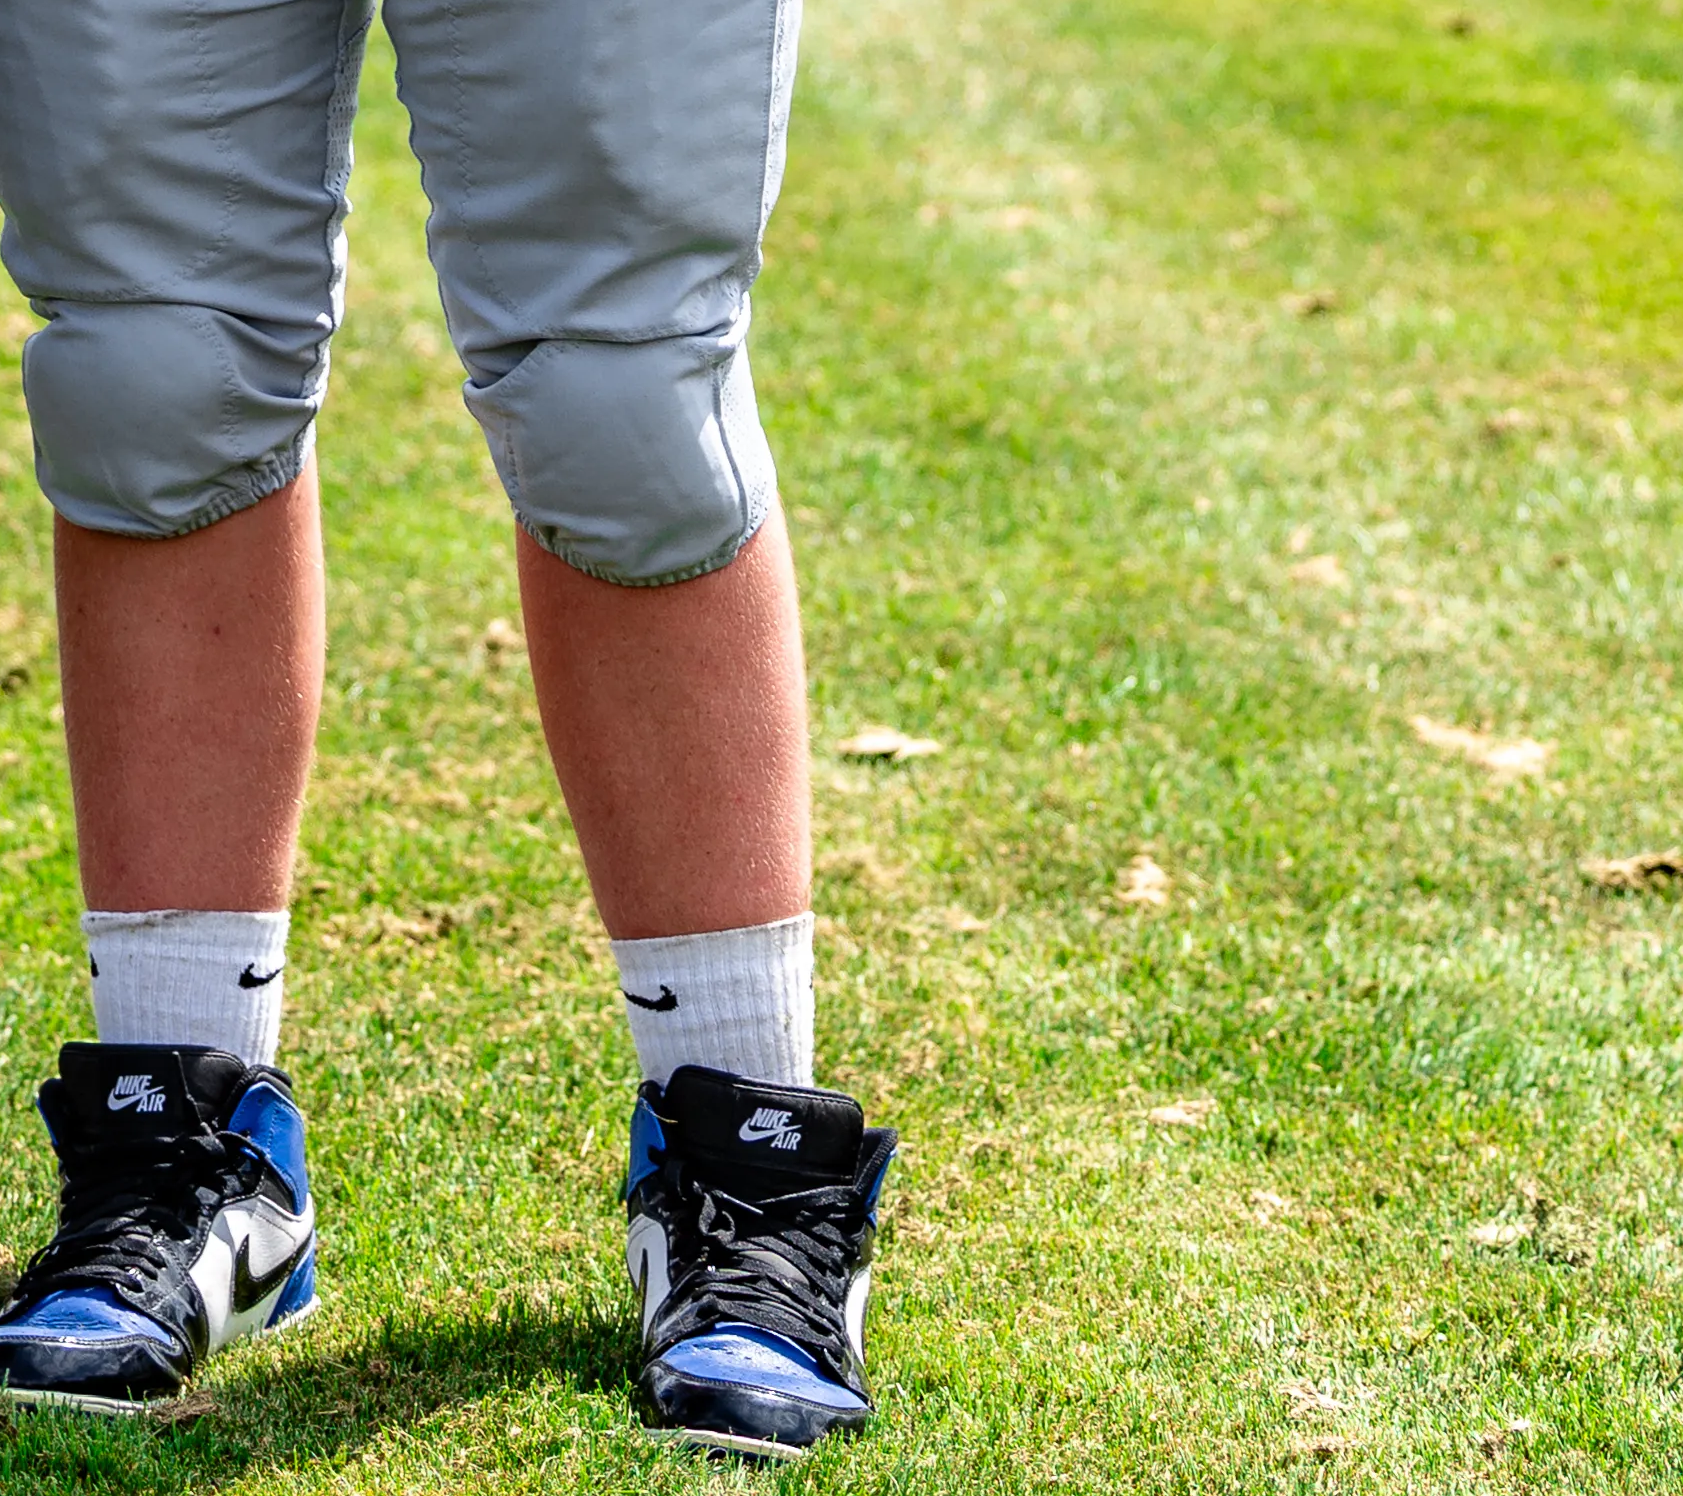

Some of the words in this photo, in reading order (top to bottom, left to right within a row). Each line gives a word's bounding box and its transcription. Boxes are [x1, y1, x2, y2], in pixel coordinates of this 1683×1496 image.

[115, 1074, 152, 1096] NIKE
[136, 1093, 166, 1112] AIR
[749, 1107, 793, 1129] NIKE
[770, 1131, 802, 1150] AIR
